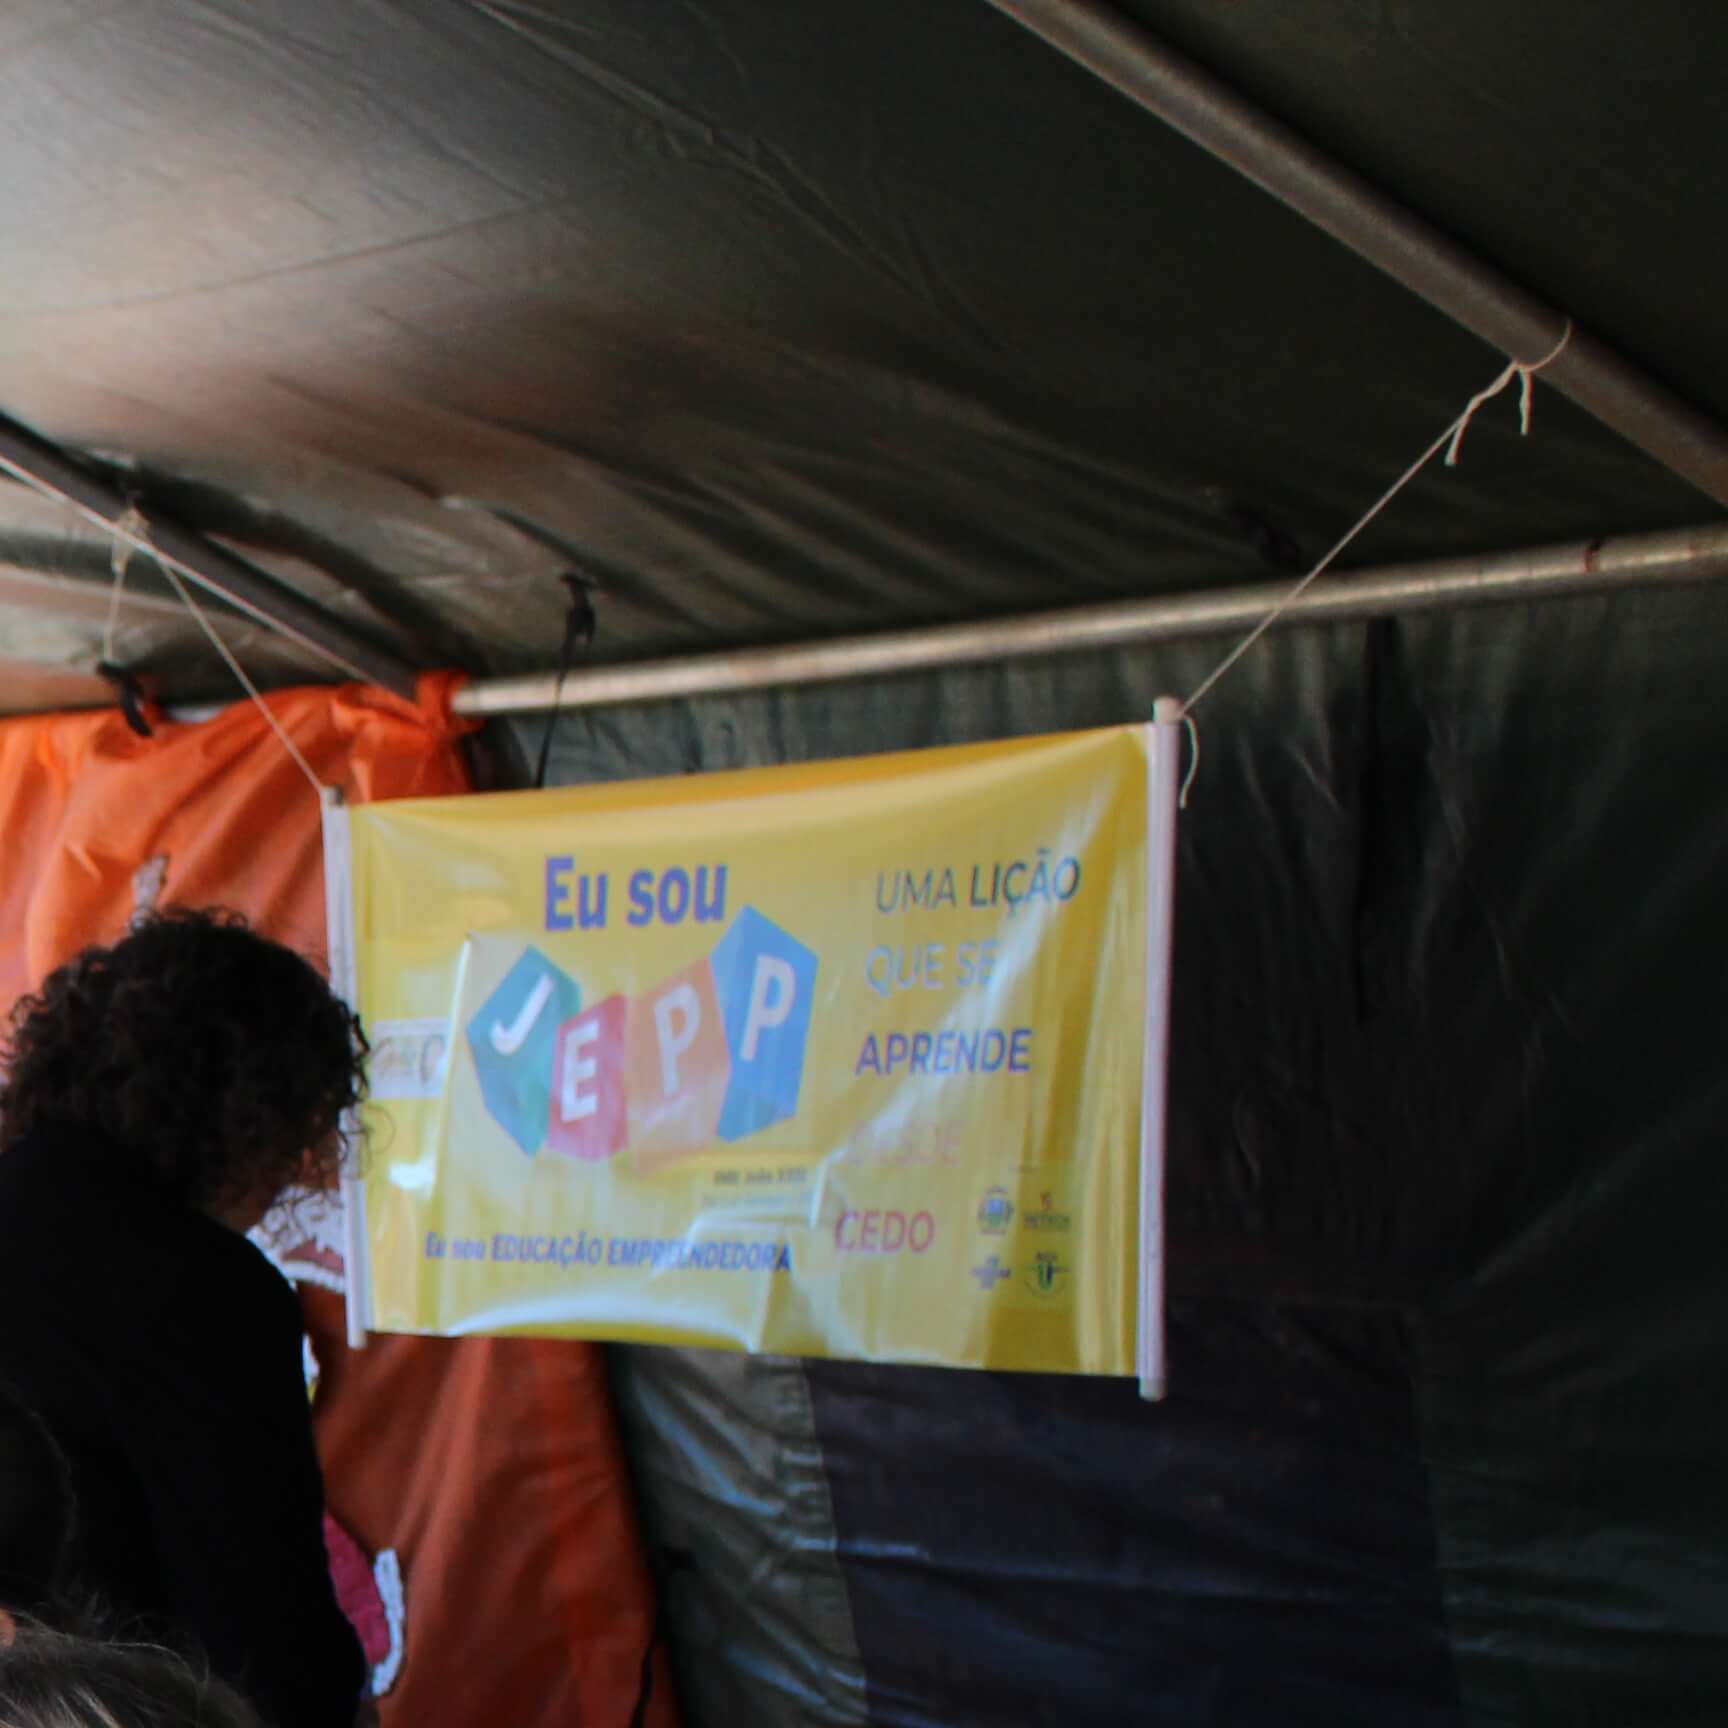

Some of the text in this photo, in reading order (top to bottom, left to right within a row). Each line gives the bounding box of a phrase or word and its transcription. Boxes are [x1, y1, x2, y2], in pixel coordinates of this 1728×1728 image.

[545, 856, 726, 931] Eu sou
[875, 848, 1081, 917] UMA LIÇÃO
[865, 938, 999, 997] QUE SE
[490, 954, 796, 1122] JEPP
[855, 1028, 1033, 1077] APRENDE
[491, 1230, 603, 1271] EDUCAÇÃO
[607, 1238, 792, 1271] EMPREENDEDORA
[834, 1208, 935, 1254] CEDO
